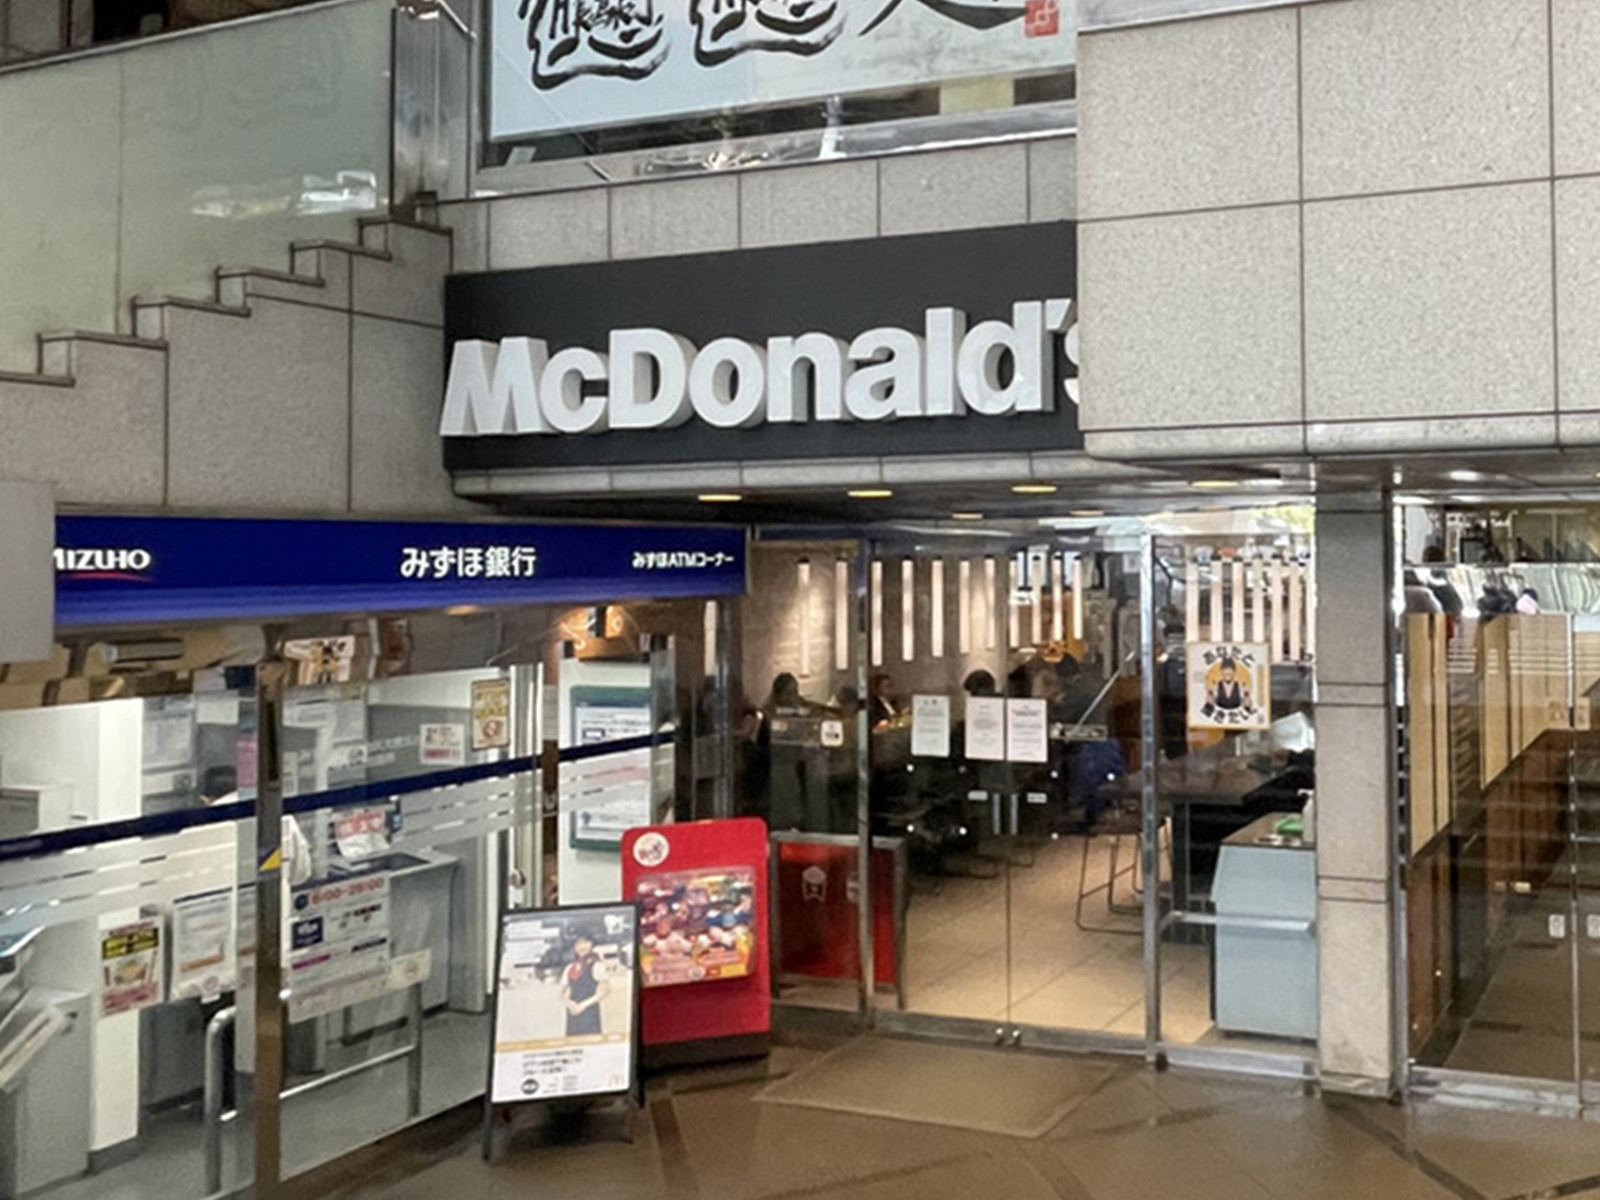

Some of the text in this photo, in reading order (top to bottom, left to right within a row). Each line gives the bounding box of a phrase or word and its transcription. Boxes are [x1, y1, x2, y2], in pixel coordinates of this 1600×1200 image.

[440, 298, 1079, 436] McDonald'
[400, 545, 537, 578] みずほ銀行
[631, 551, 735, 569] みずほATMコーナー
